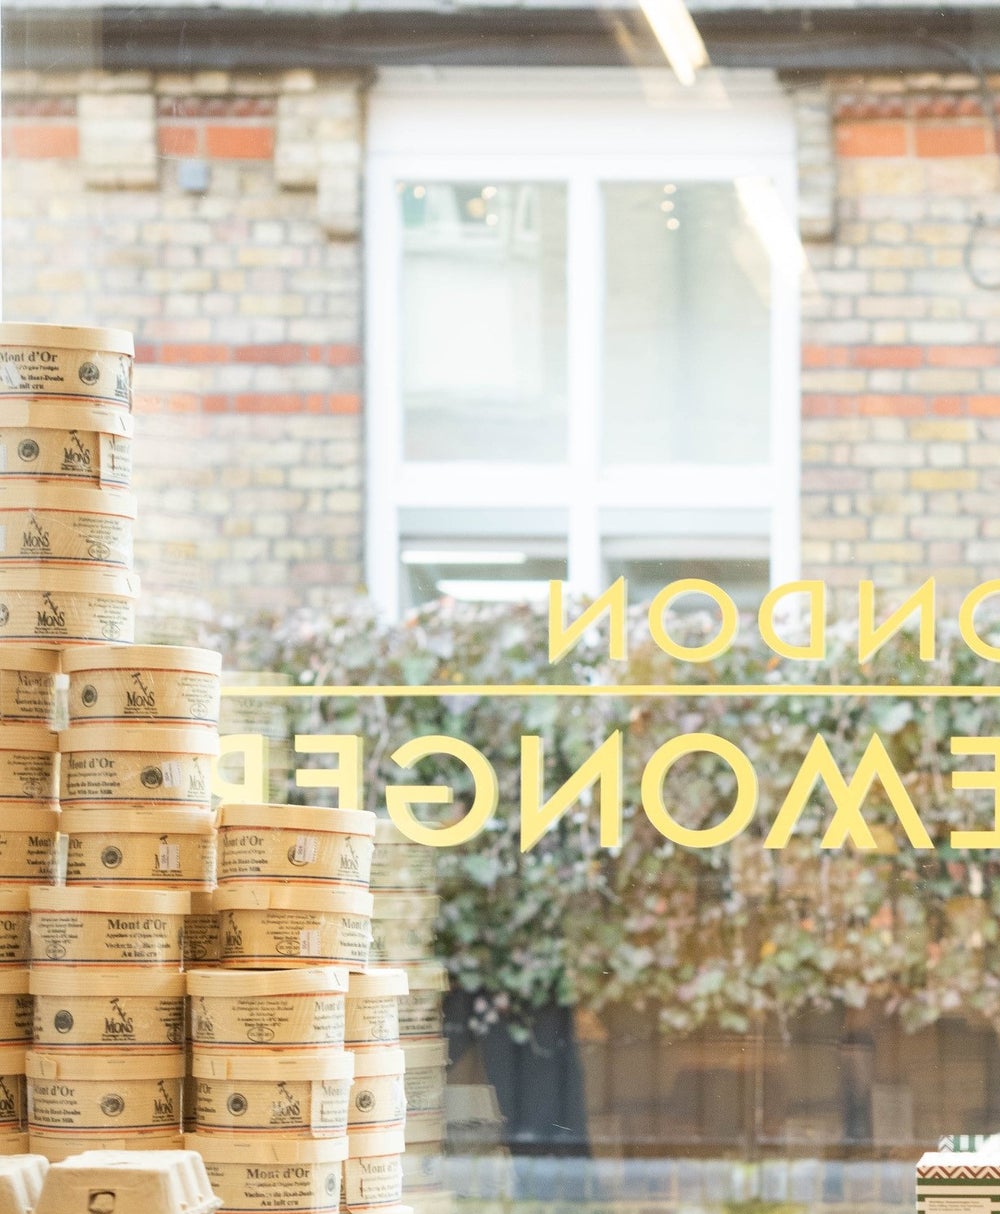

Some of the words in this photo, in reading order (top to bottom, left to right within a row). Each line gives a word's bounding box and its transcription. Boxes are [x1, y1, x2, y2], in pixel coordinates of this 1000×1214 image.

[28, 351, 58, 362] d'Or
[23, 532, 50, 547] MONS
[37, 611, 65, 627] MONS
[127, 691, 155, 707] MONS
[89, 758, 115, 768] d'Or
[108, 919, 139, 930] Mont
[143, 919, 167, 930] d'Or
[51, 1085, 74, 1096] d'Or
[247, 1168, 279, 1179] Mont
[283, 1168, 309, 1178] d'Or
